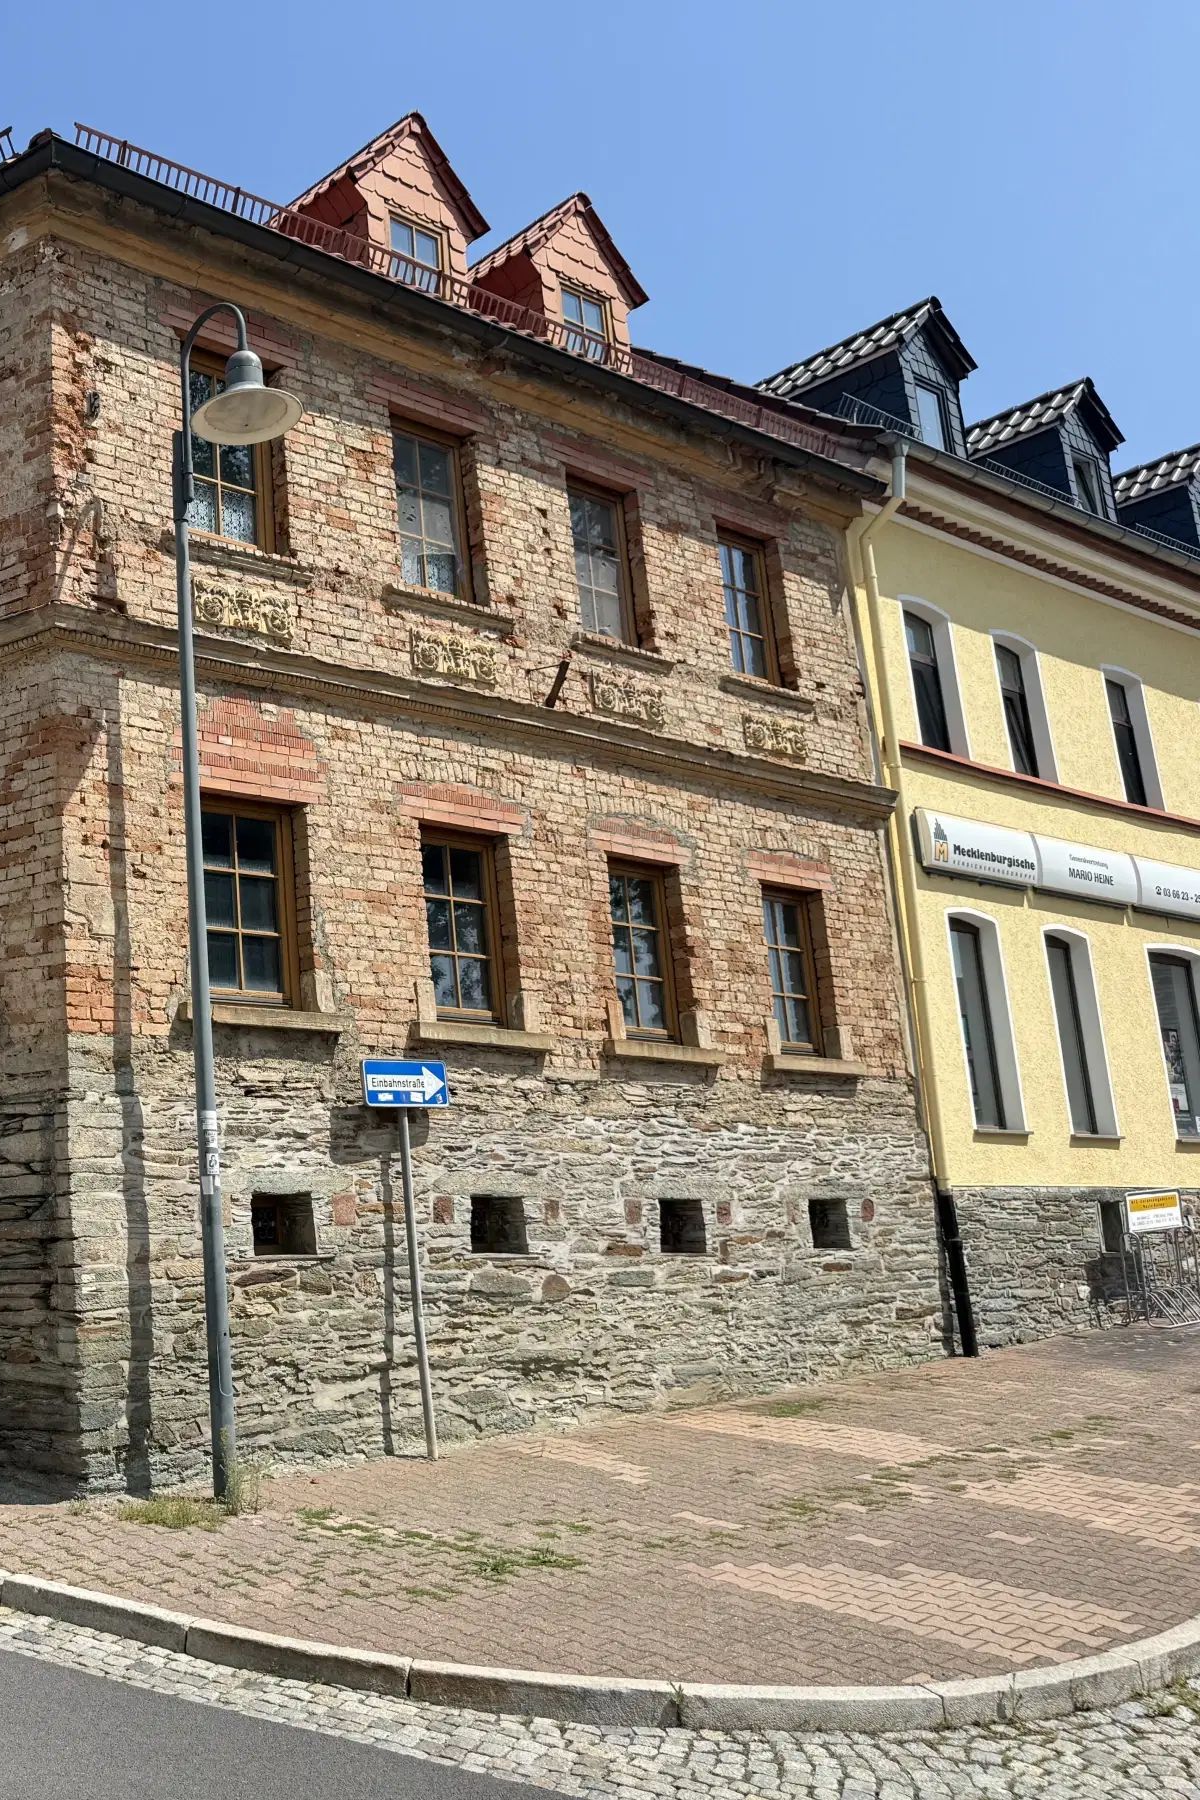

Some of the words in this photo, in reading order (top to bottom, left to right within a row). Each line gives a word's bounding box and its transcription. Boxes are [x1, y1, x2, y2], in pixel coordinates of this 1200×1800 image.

[953, 844, 1035, 870] Mecklenburgische
[1068, 867, 1093, 882] MARIO
[1094, 872, 1114, 886] HEINE
[1163, 887, 1171, 898] 03
[1172, 889, 1180, 900] 66
[1181, 891, 1189, 901] 23
[371, 1077, 425, 1088] Einbahnstraße
